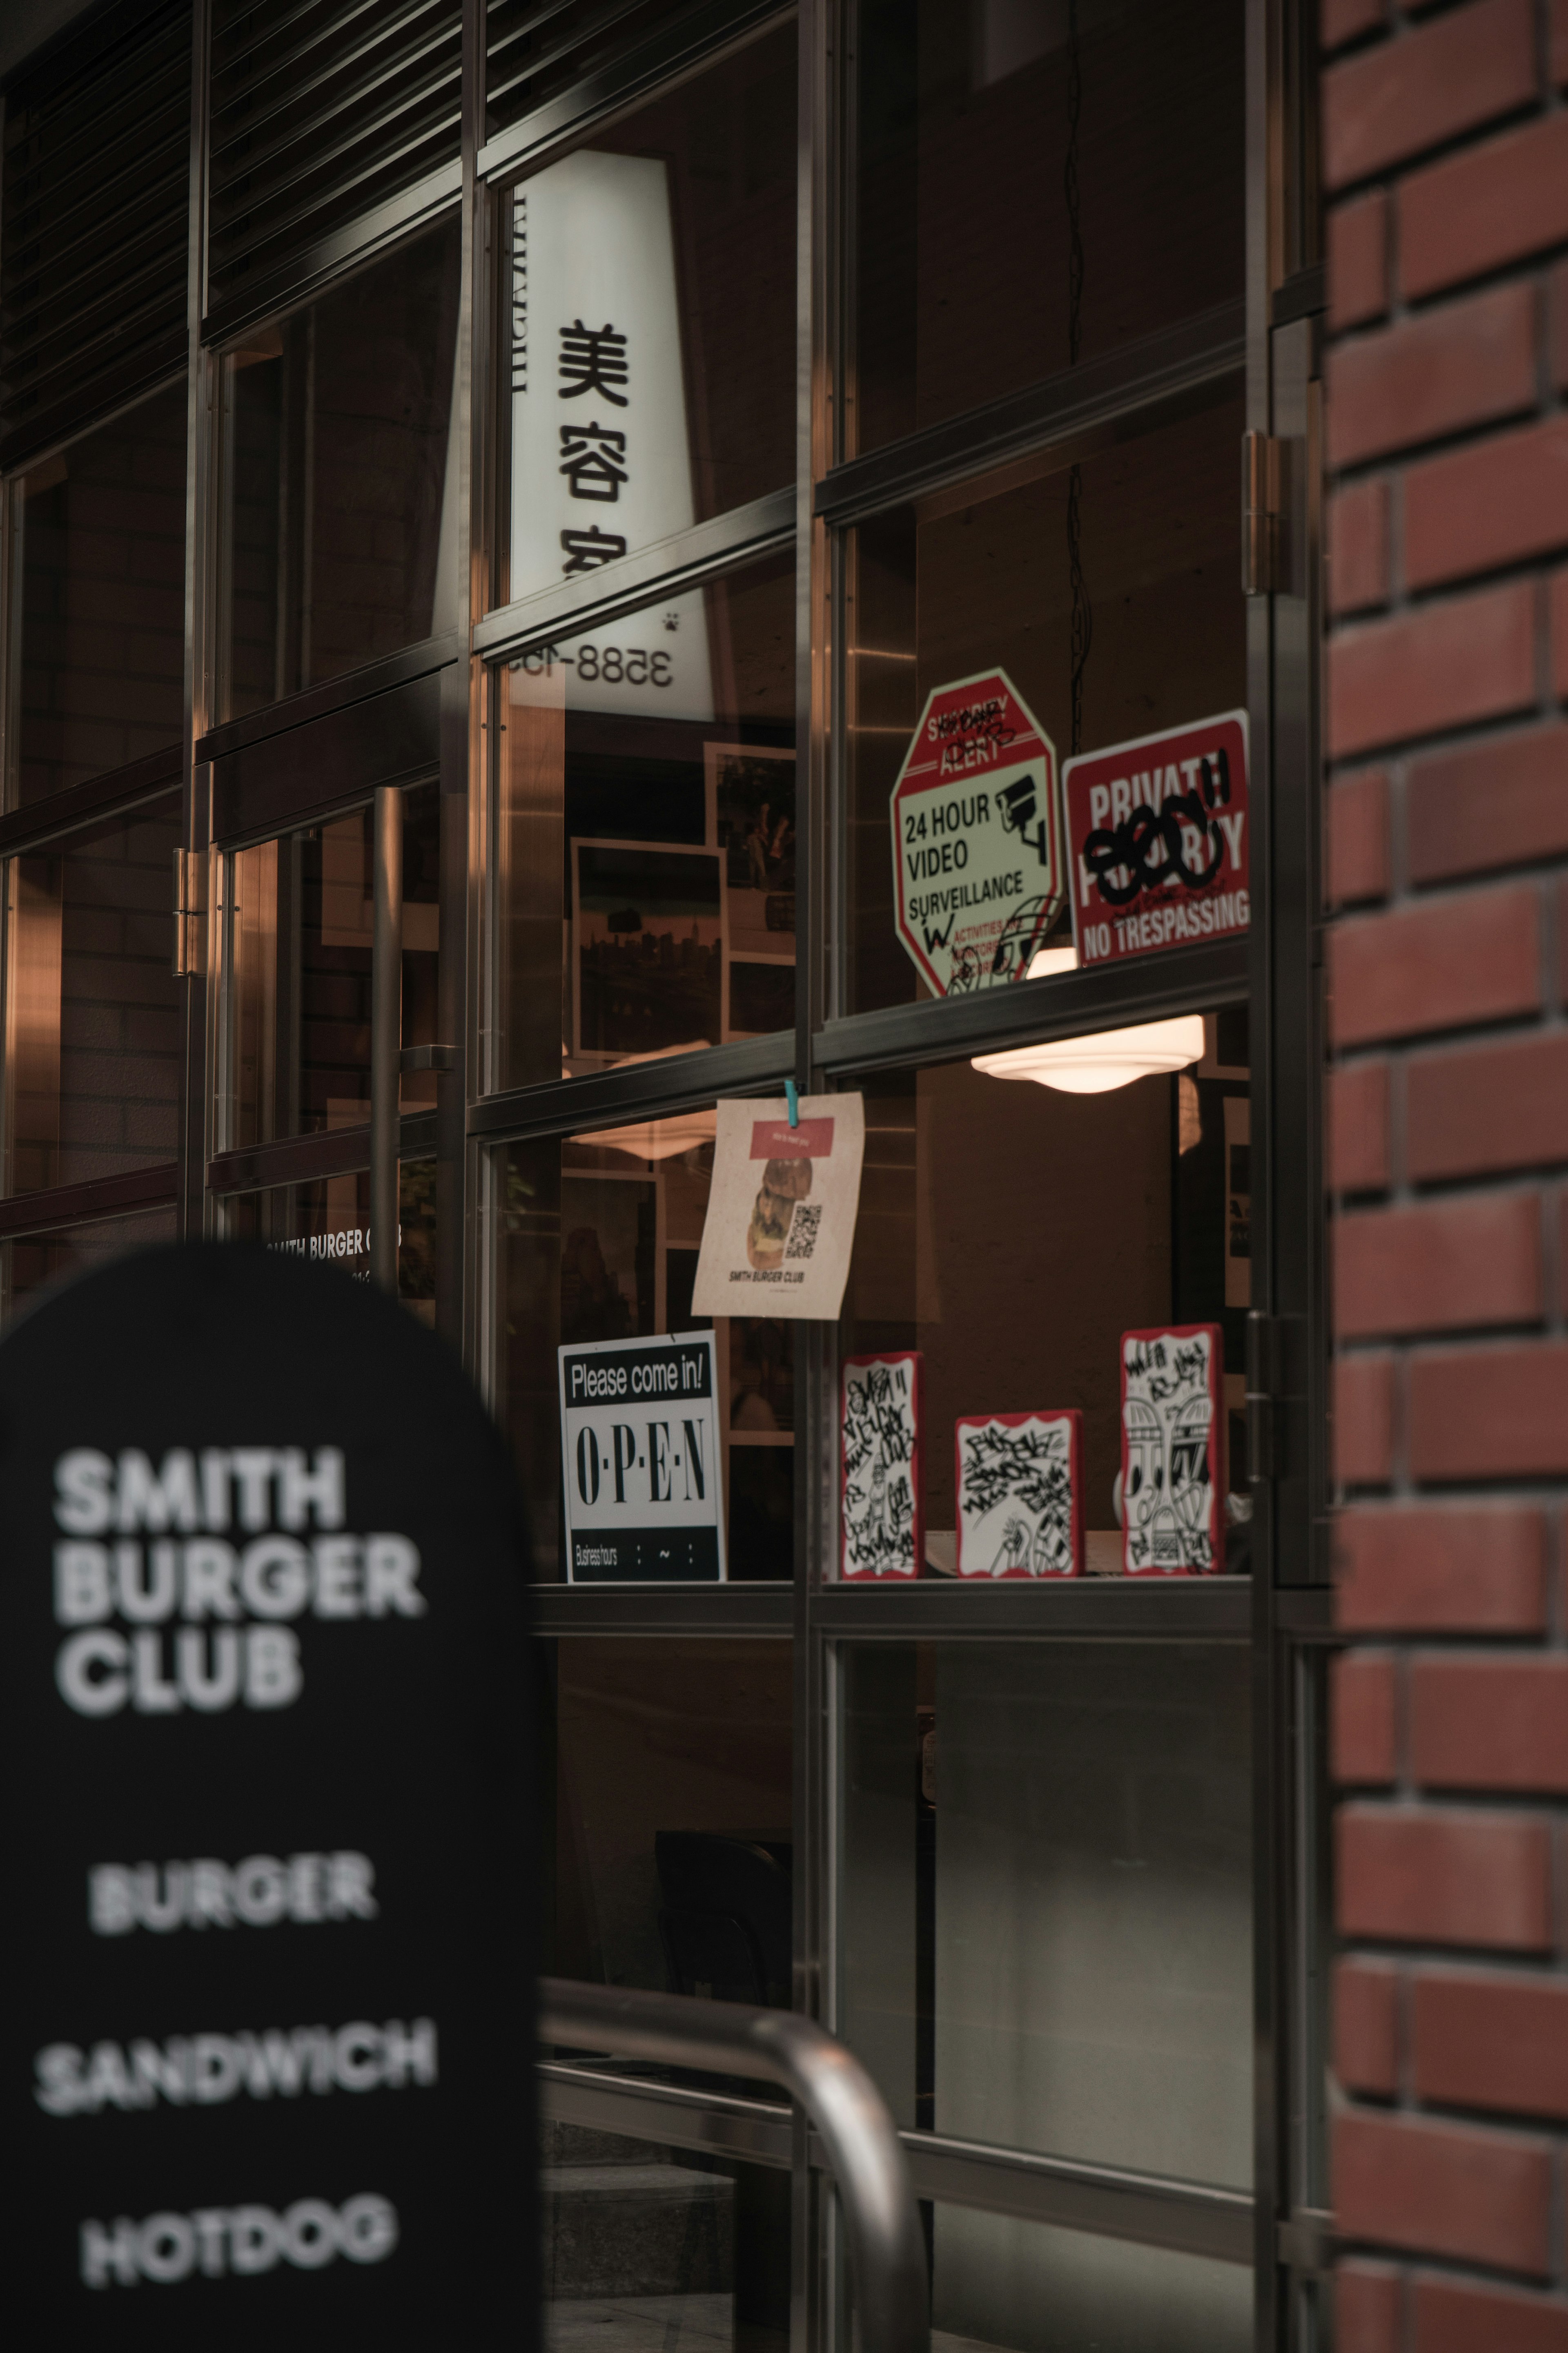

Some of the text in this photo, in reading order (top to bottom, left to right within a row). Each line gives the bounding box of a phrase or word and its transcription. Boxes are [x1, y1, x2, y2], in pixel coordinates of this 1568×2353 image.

[905, 793, 990, 844] 24 HOUR
[907, 839, 968, 881] VIDEO
[1078, 811, 1245, 907] PRTY
[909, 870, 1023, 921] SURVEILLANCE
[1084, 923, 1111, 960] NO
[1113, 889, 1250, 952] TRESPASSING
[310, 1229, 363, 1261] BURGER
[752, 1271, 782, 1282] BURGER
[783, 1271, 804, 1283] CLUB
[572, 1352, 703, 1398] Please come in!
[54, 1447, 346, 1536] SMITH
[54, 1532, 428, 1628] BURGER
[576, 1543, 618, 1566] Business hours
[55, 1623, 304, 1717] CLUB
[88, 1850, 378, 1936] BURGER
[34, 2016, 439, 2117] SANDWICH
[81, 2192, 399, 2288] HOTDOG
